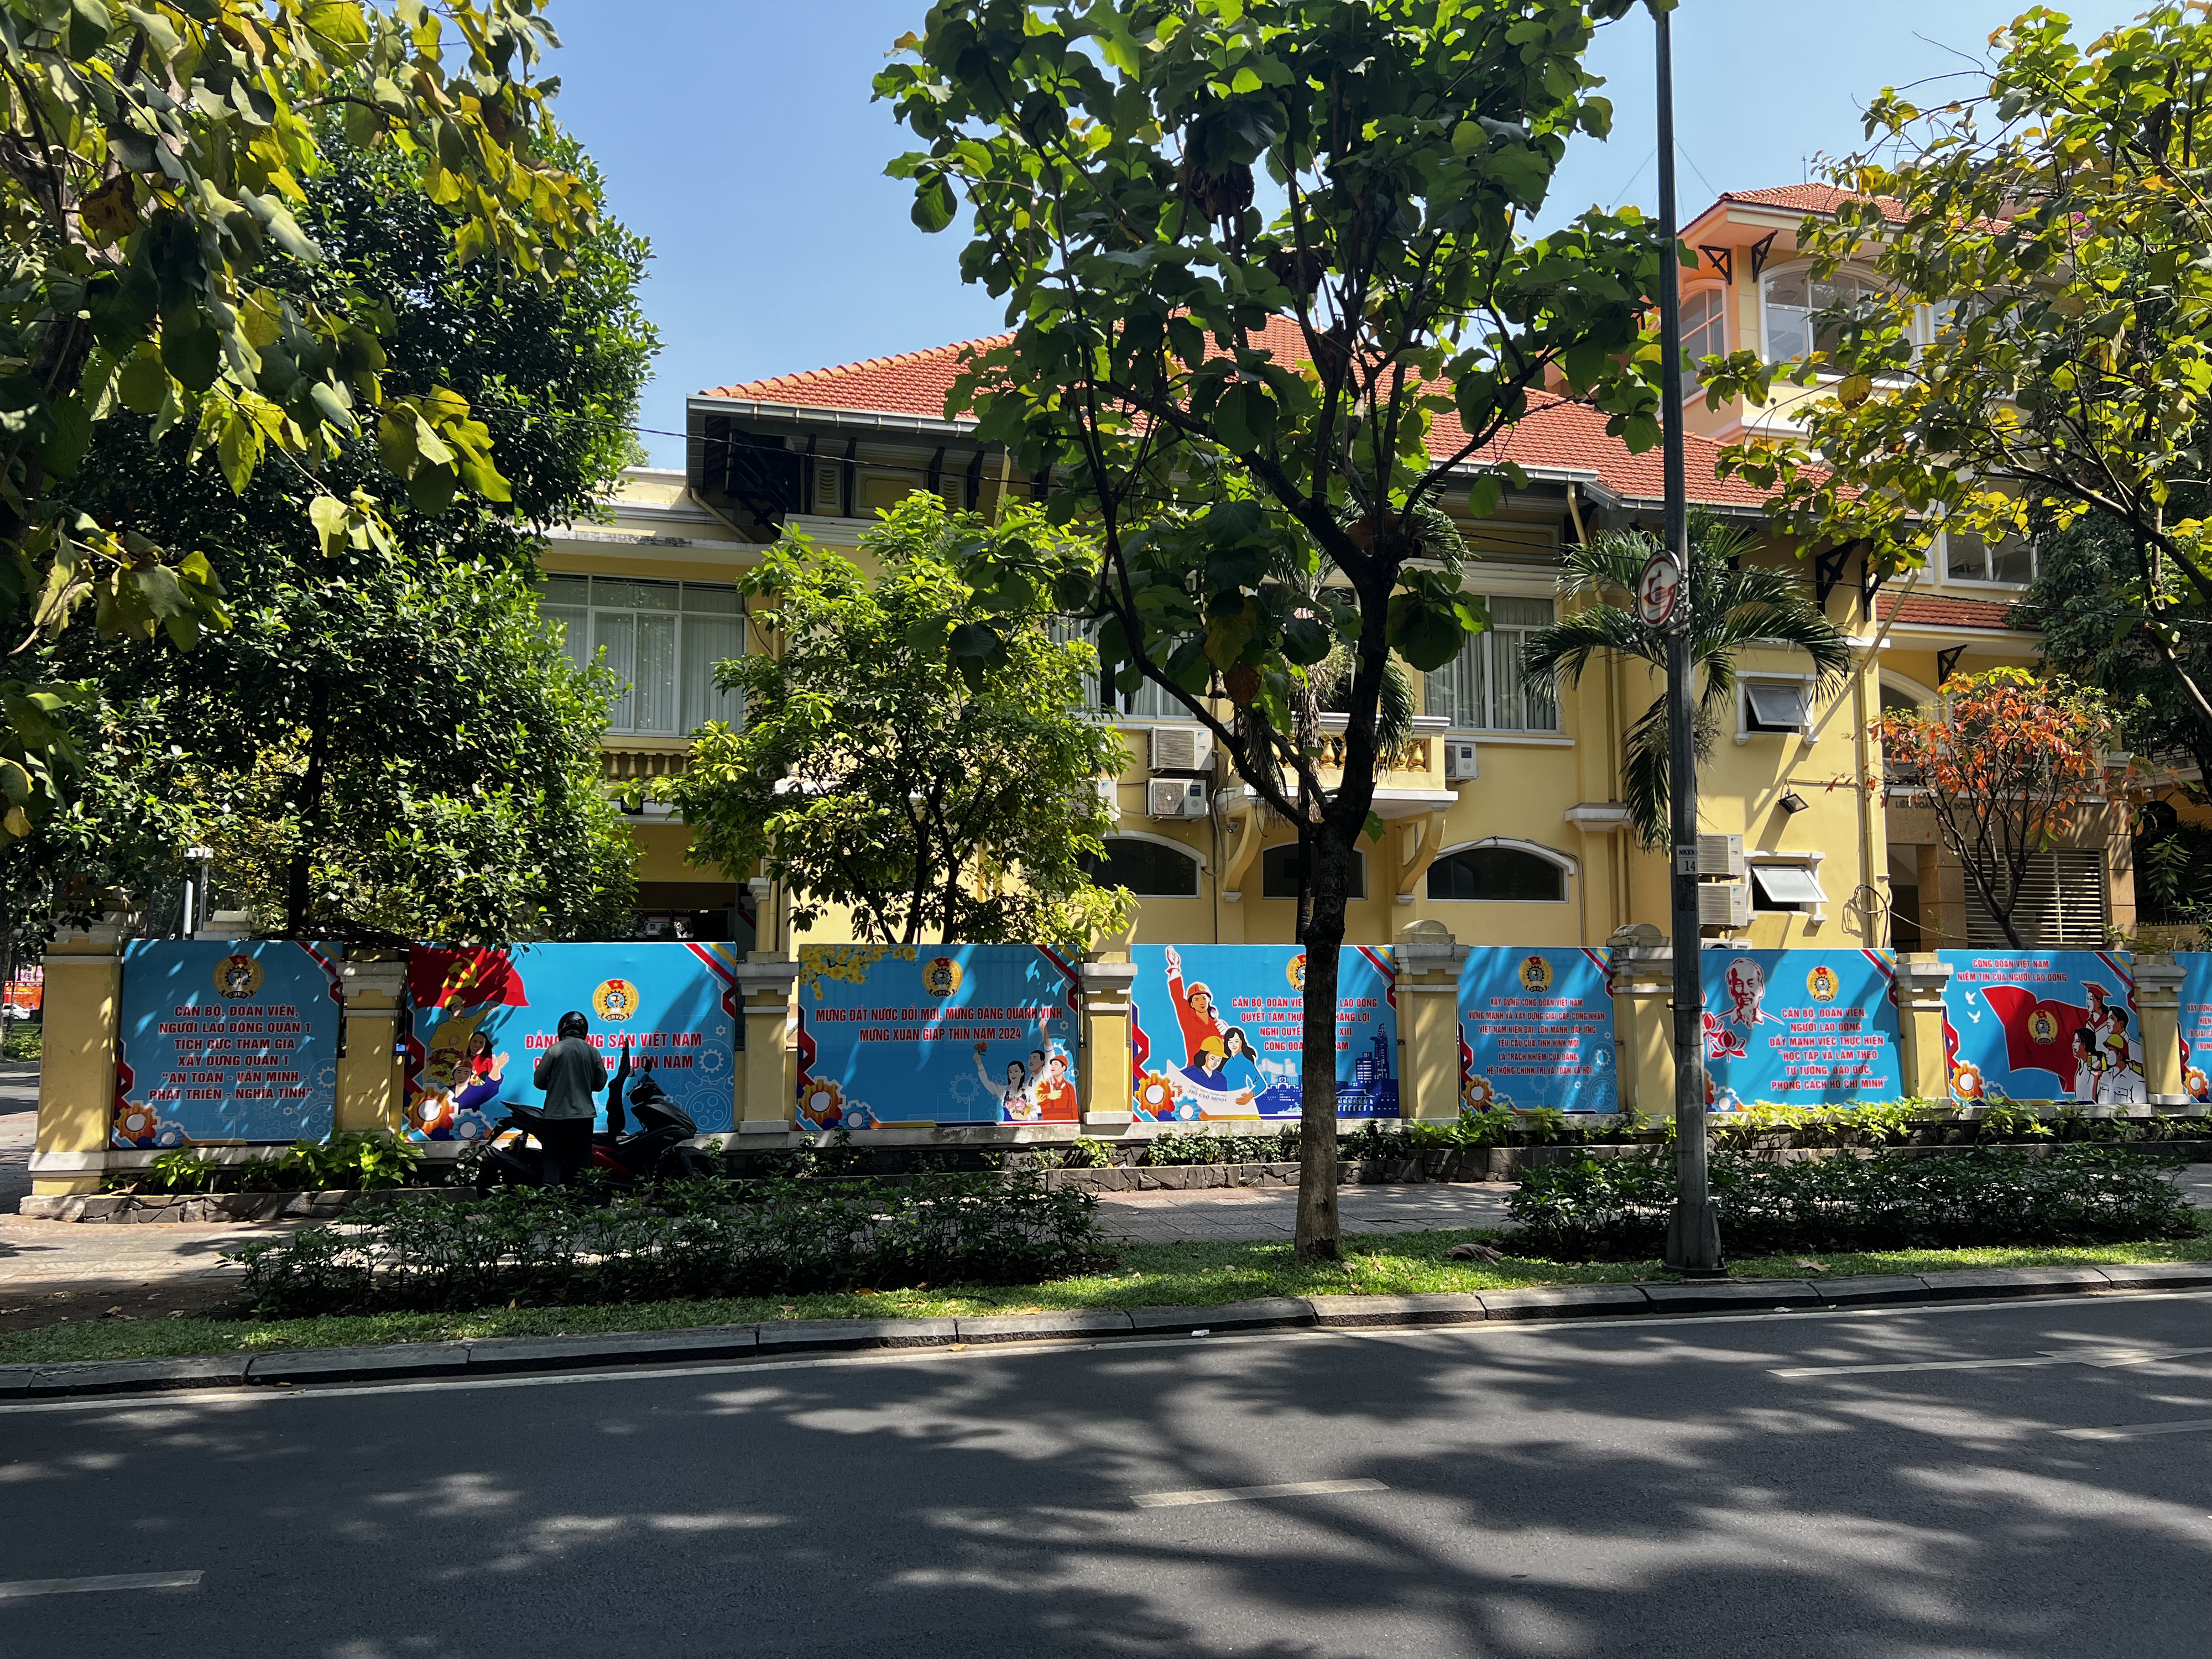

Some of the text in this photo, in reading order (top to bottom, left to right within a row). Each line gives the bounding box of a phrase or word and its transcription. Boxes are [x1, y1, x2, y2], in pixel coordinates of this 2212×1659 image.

[1685, 860, 1695, 872] 14
[1973, 958, 1992, 968] CÔNG
[1995, 958, 2013, 968] ĐOÀN
[2016, 958, 2031, 969] VIỆT
[1978, 973, 1990, 981] TIN
[1992, 971, 2007, 981] CỦA
[2009, 971, 2031, 981] NGƯỜI
[2048, 972, 2067, 983] ĐỘNG
[1232, 997, 1378, 1009] CÁN BỘ, ĐOÀN VIÊ LAO ĐỘNG
[1521, 997, 1537, 1006] CÔNG
[1556, 997, 1568, 1008] VIỆT
[174, 1004, 299, 1019] CÁN BỘ, ĐOÀN VIÊN,
[816, 1006, 846, 1021] MỪNG
[849, 1004, 868, 1021] ĐẤT
[871, 1005, 898, 1021] NƯỚC
[901, 1004, 917, 1021] ĐỔI
[921, 1005, 943, 1022] MỚI,
[946, 1005, 974, 1020] MỪNG
[977, 1004, 1003, 1020] ĐẢNG
[1041, 1007, 1062, 1019] VINH
[1241, 1009, 1370, 1024] QUYẾT TÂM HẮNG LỢI
[1486, 1012, 1504, 1021] MẠNH
[1559, 1010, 1570, 1020] CẤP
[1572, 1011, 1587, 1020] CÔNG
[1819, 1006, 1843, 1017] ĐOÀN
[1845, 1007, 1867, 1018] VIÊN,
[159, 1020, 310, 1035] NGƯỜI LAO ĐỘNG QUẬN 1
[859, 1025, 1021, 1041] MỪNG XUÂN GIÁP THÌN NĂM 2024
[1260, 1027, 1352, 1038] NGHỊ XIII
[1479, 1024, 1491, 1035] VIỆT
[1791, 1021, 1861, 1033] NGƯỜI LAO ĐỘNG
[175, 1037, 295, 1051] TÍCH CỰC THAM GIA
[609, 1029, 635, 1048] SẢN
[640, 1031, 668, 1050] VIỆT
[671, 1033, 702, 1046] NAM
[1265, 1040, 1349, 1051] CÔNG ĐOÀ AM
[1498, 1037, 1509, 1047] YÊU
[1524, 1035, 1536, 1047] CỦA
[1790, 1037, 1815, 1047] MẠNH
[1818, 1035, 1837, 1047] VIỆC
[1839, 1036, 1861, 1047] THỰC
[1864, 1034, 1884, 1047] HIỆN
[178, 1053, 289, 1068] XÂY DỰNG QUẬN 1
[620, 1052, 659, 1070] UÔN
[664, 1053, 693, 1068] NĂM
[1803, 1049, 1878, 1062] TẬP VÀ LÀM THEO
[1496, 1063, 1515, 1074] THỐNG
[1557, 1065, 1571, 1074] TOÀN
[1786, 1066, 1797, 1075] TƯ
[1833, 1066, 1850, 1076] ĐẠO
[191, 1070, 224, 1083] TOÀN
[237, 1070, 263, 1082] VĂN
[266, 1072, 299, 1082] MINH
[1771, 1081, 1801, 1090] PHONG
[1804, 1079, 1827, 1089] CÁCH
[1830, 1077, 1841, 1088] HỒ
[1844, 1079, 1858, 1088] CHÍ
[149, 1087, 181, 1100] PHÁT
[186, 1084, 222, 1099] TRIỂN
[236, 1086, 274, 1099] NGHĨA
